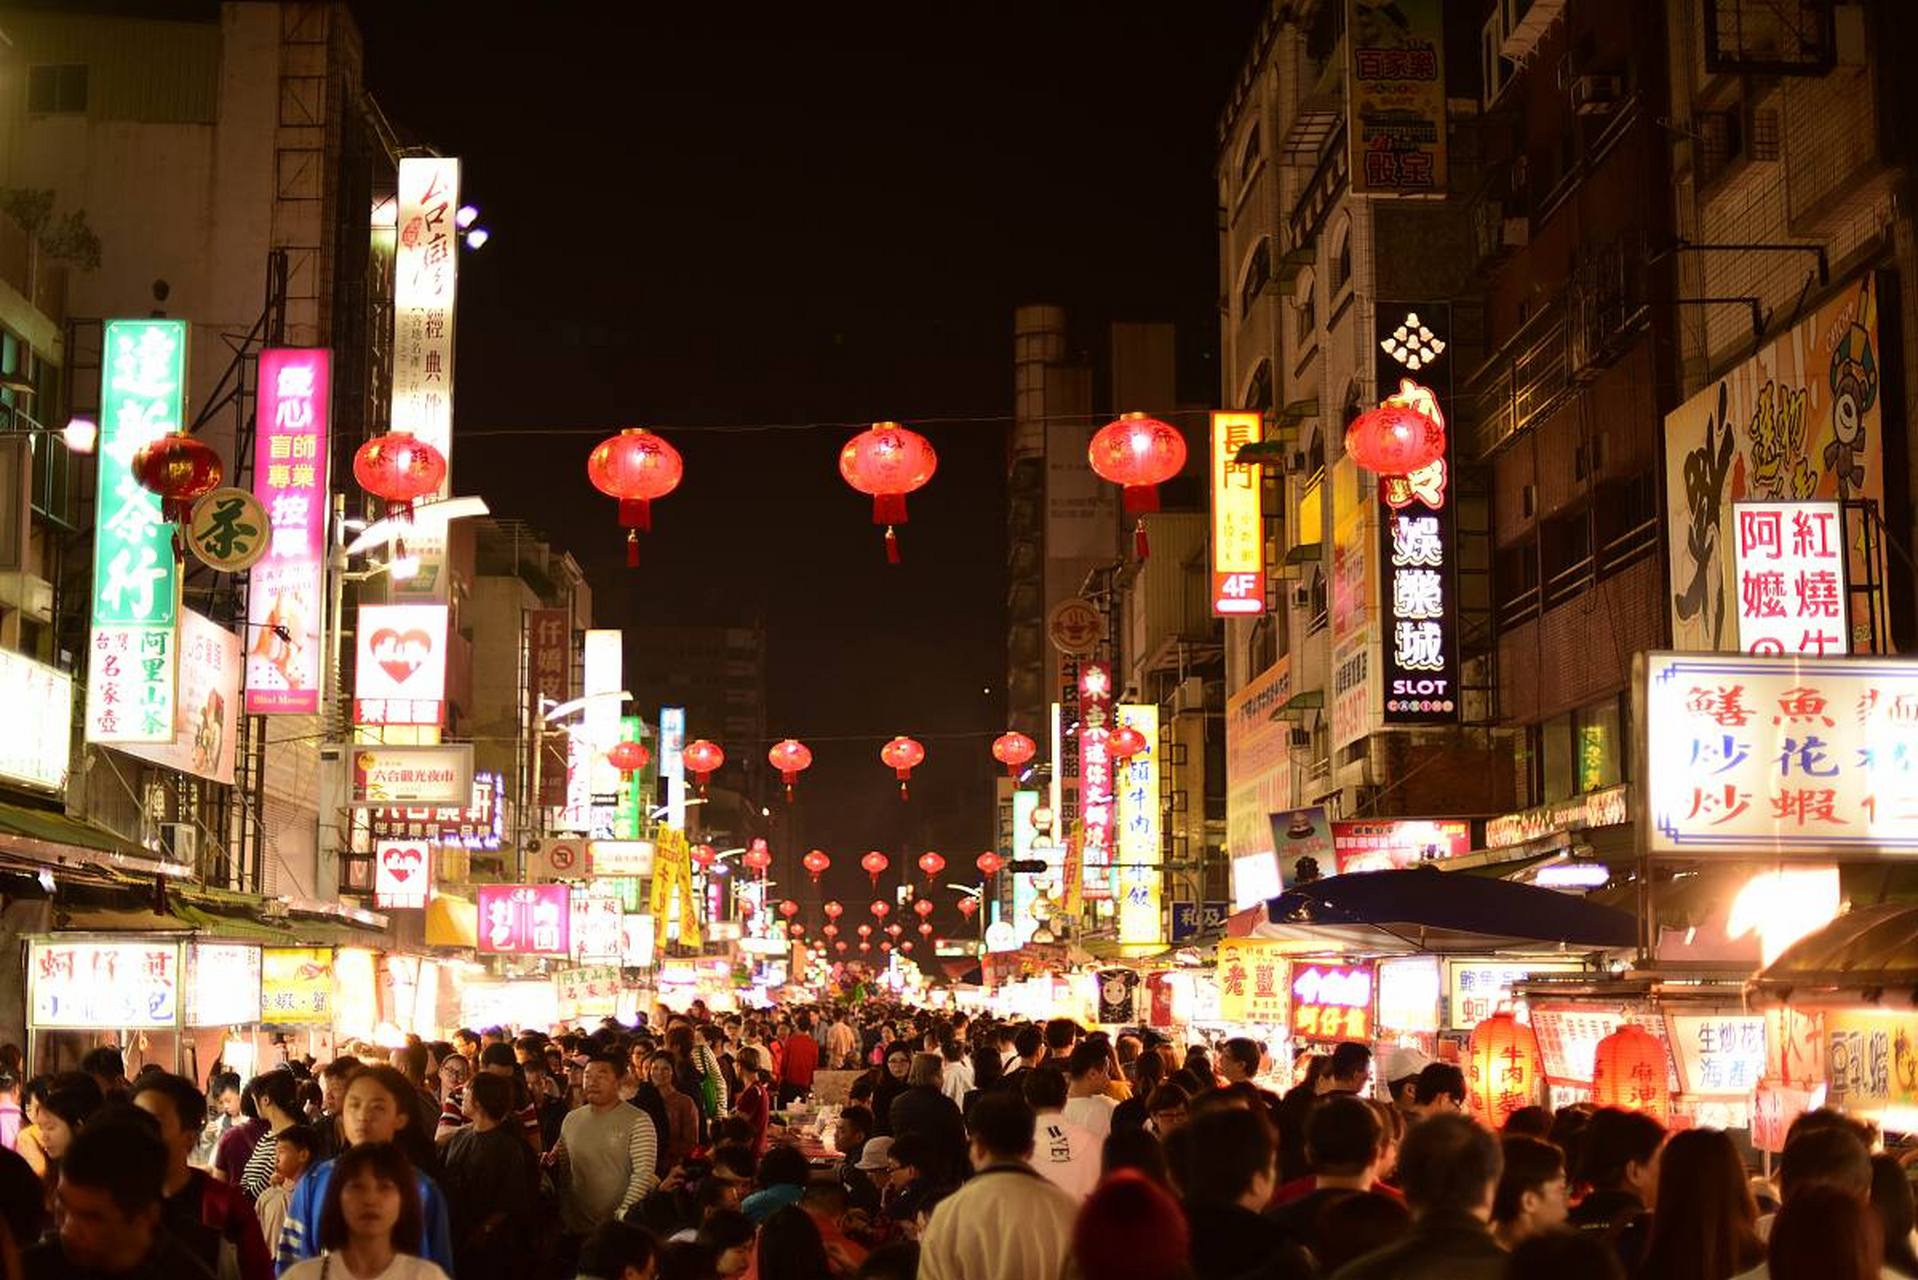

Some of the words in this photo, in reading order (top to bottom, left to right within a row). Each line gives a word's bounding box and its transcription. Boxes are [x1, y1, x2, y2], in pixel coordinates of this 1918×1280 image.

[196, 497, 258, 560] 茶
[1222, 574, 1256, 597] 4F
[1391, 516, 1445, 672] 娛樂城
[138, 629, 170, 736] 阿里山茶
[1393, 680, 1448, 695] SLOT
[373, 769, 455, 783] 六合觀光夜市
[1698, 1022, 1766, 1054] 生炒花
